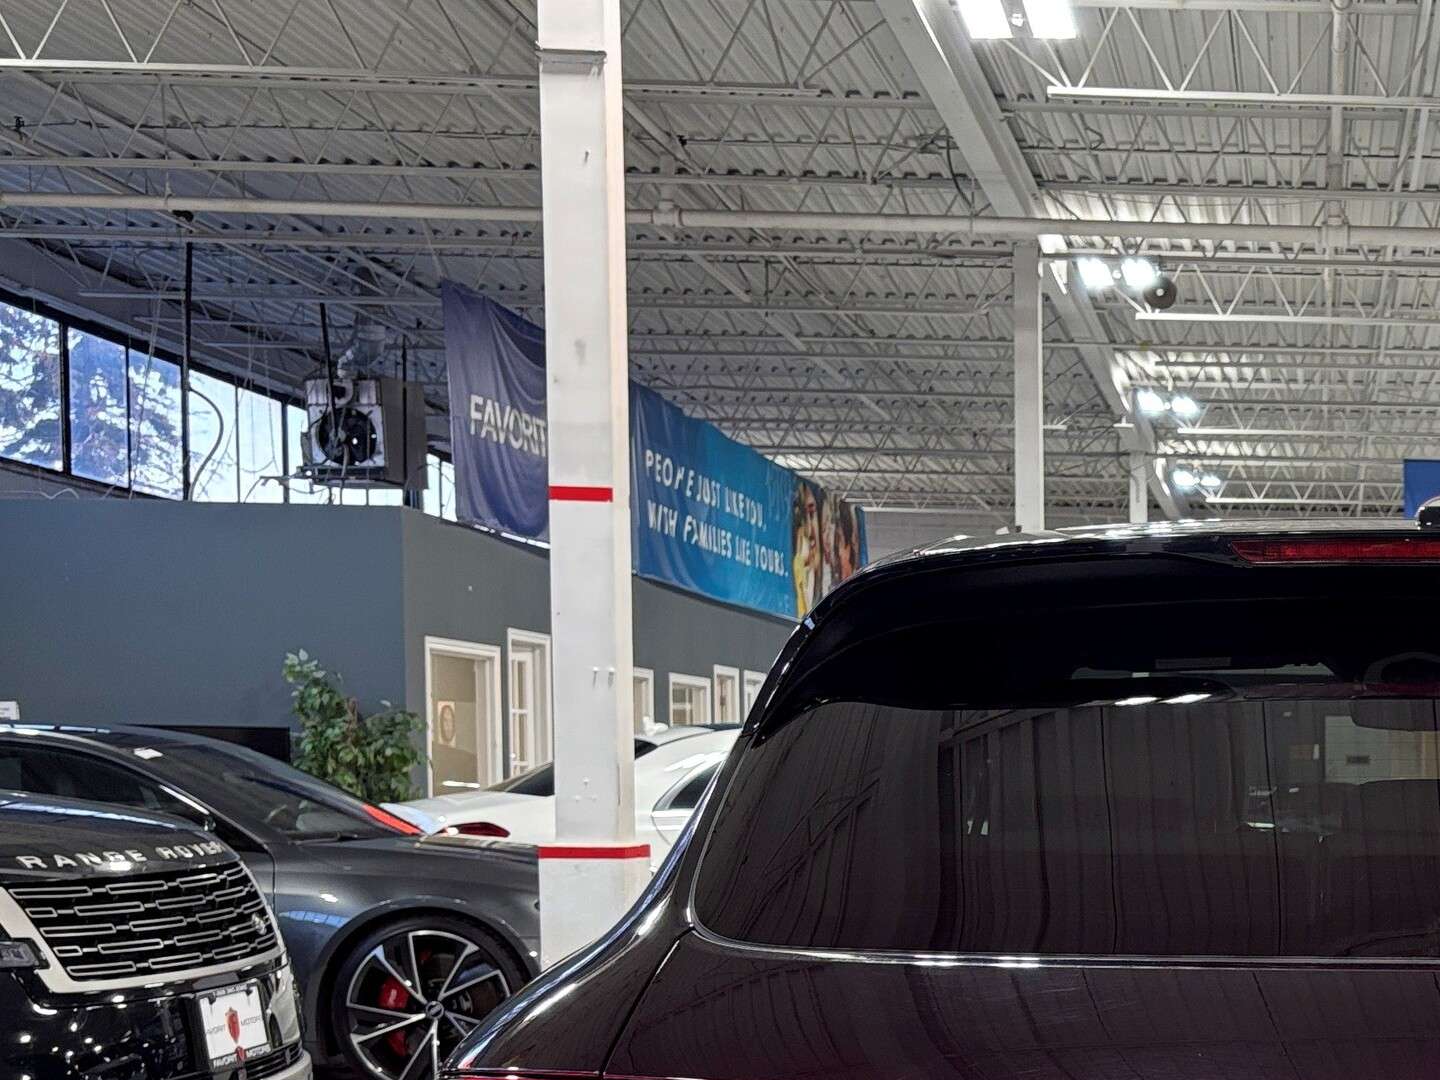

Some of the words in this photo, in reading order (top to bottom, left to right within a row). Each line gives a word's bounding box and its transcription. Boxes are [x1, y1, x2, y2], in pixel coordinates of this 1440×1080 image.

[470, 394, 546, 457] FAVORIT
[697, 475, 721, 508] JUST
[648, 500, 678, 538] WITH
[16, 850, 147, 868] RANGE
